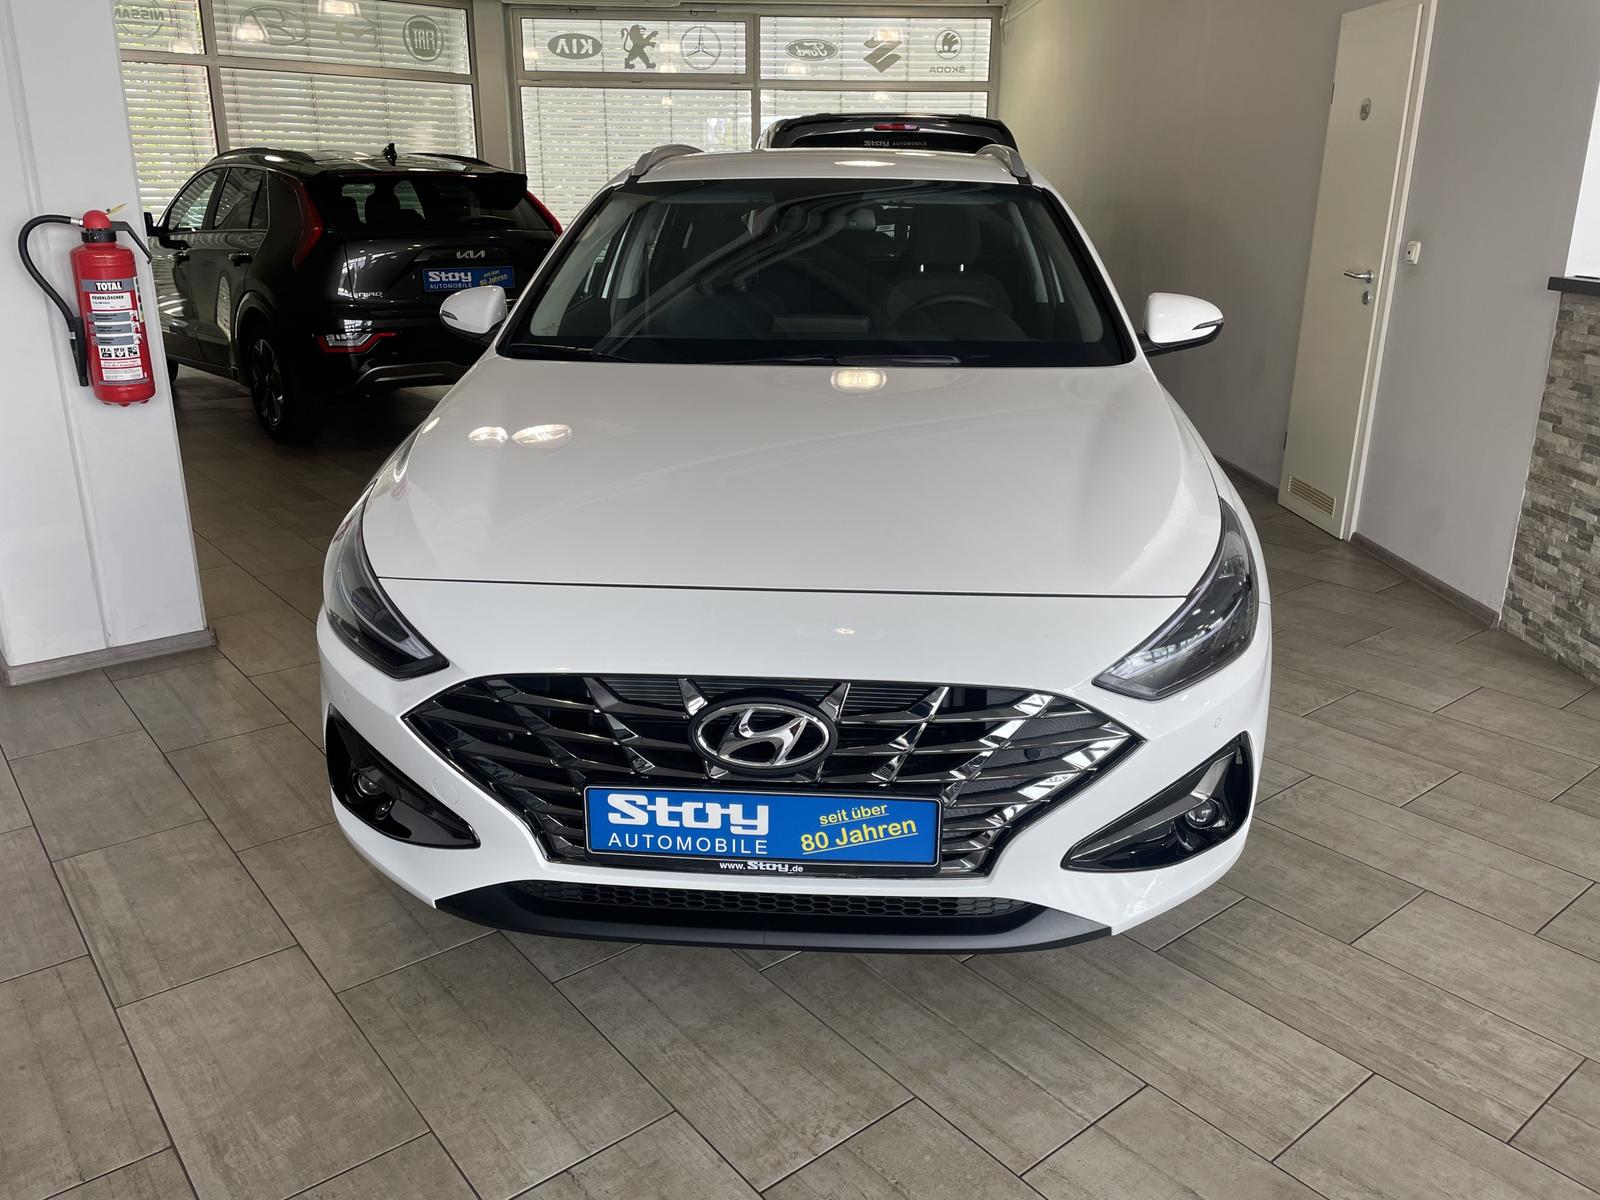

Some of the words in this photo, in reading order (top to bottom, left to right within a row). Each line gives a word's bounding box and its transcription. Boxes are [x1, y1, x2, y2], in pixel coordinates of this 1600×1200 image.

[96, 282, 122, 291] TOTAL
[428, 271, 473, 282] Stoy
[429, 282, 473, 290] AUTOMOBILE
[607, 793, 769, 836] Stoy
[819, 809, 849, 825] seit
[851, 804, 888, 820] über
[608, 832, 768, 855] AUTOMOBILE
[800, 831, 829, 852] 80
[835, 819, 917, 847] Jahren
